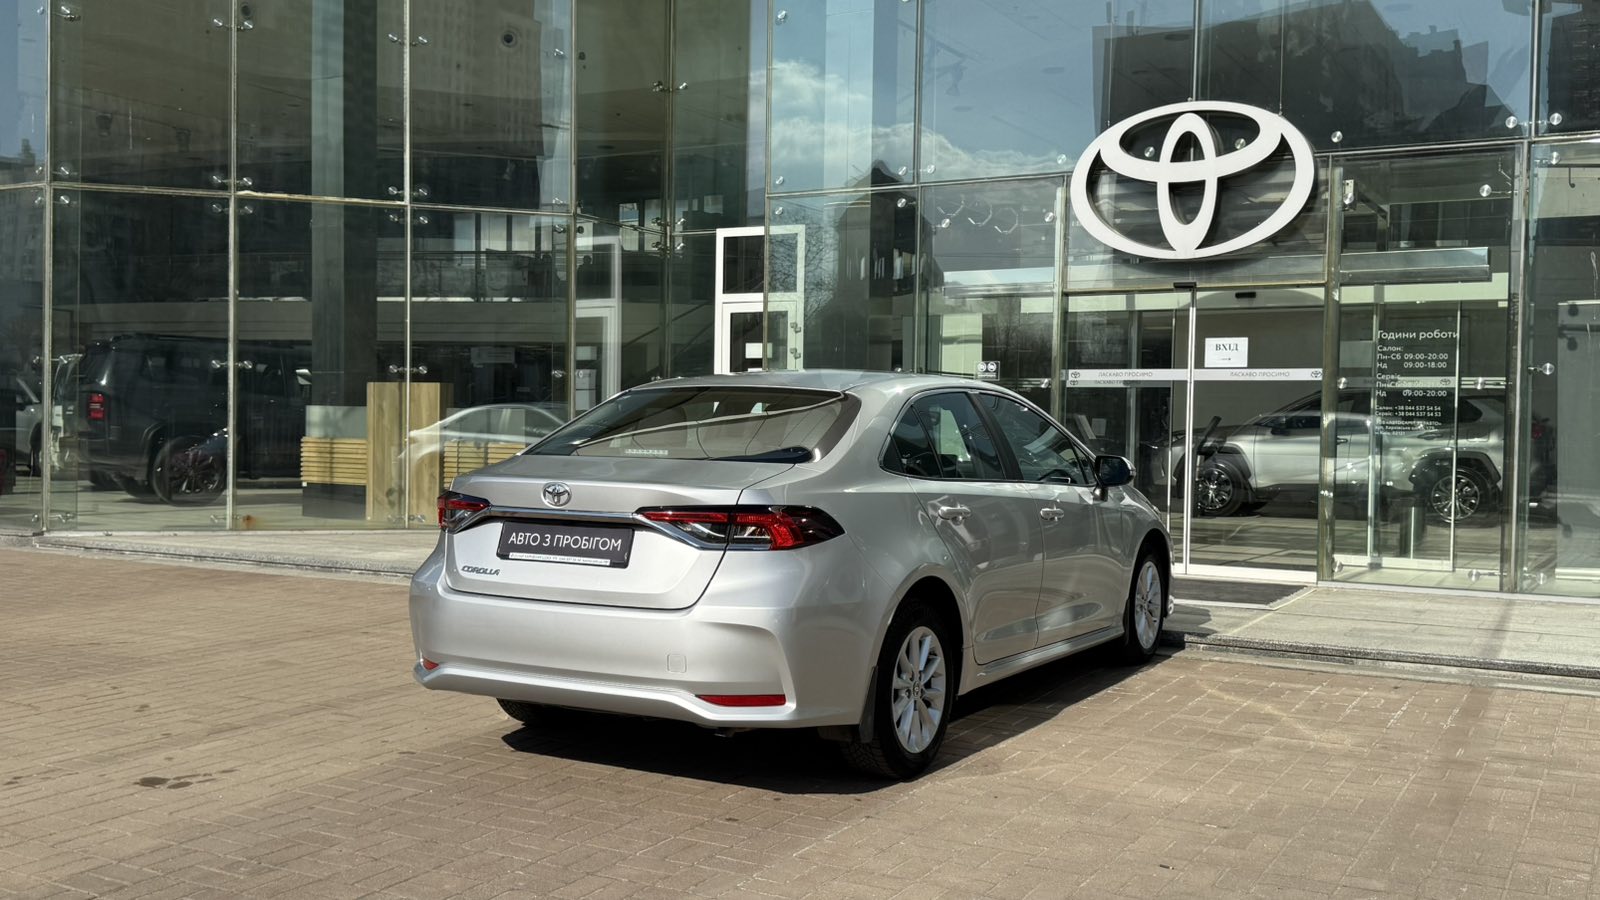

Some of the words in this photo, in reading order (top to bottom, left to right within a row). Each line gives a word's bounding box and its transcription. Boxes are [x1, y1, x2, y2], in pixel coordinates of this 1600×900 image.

[1377, 330, 1416, 340] Години
[1419, 329, 1458, 340] роботи
[1215, 343, 1239, 352] ВХІД
[508, 532, 541, 546] АВТО
[542, 534, 551, 547] З
[553, 534, 622, 551] ПРОБІГОМ
[461, 565, 500, 576] COROLLA
